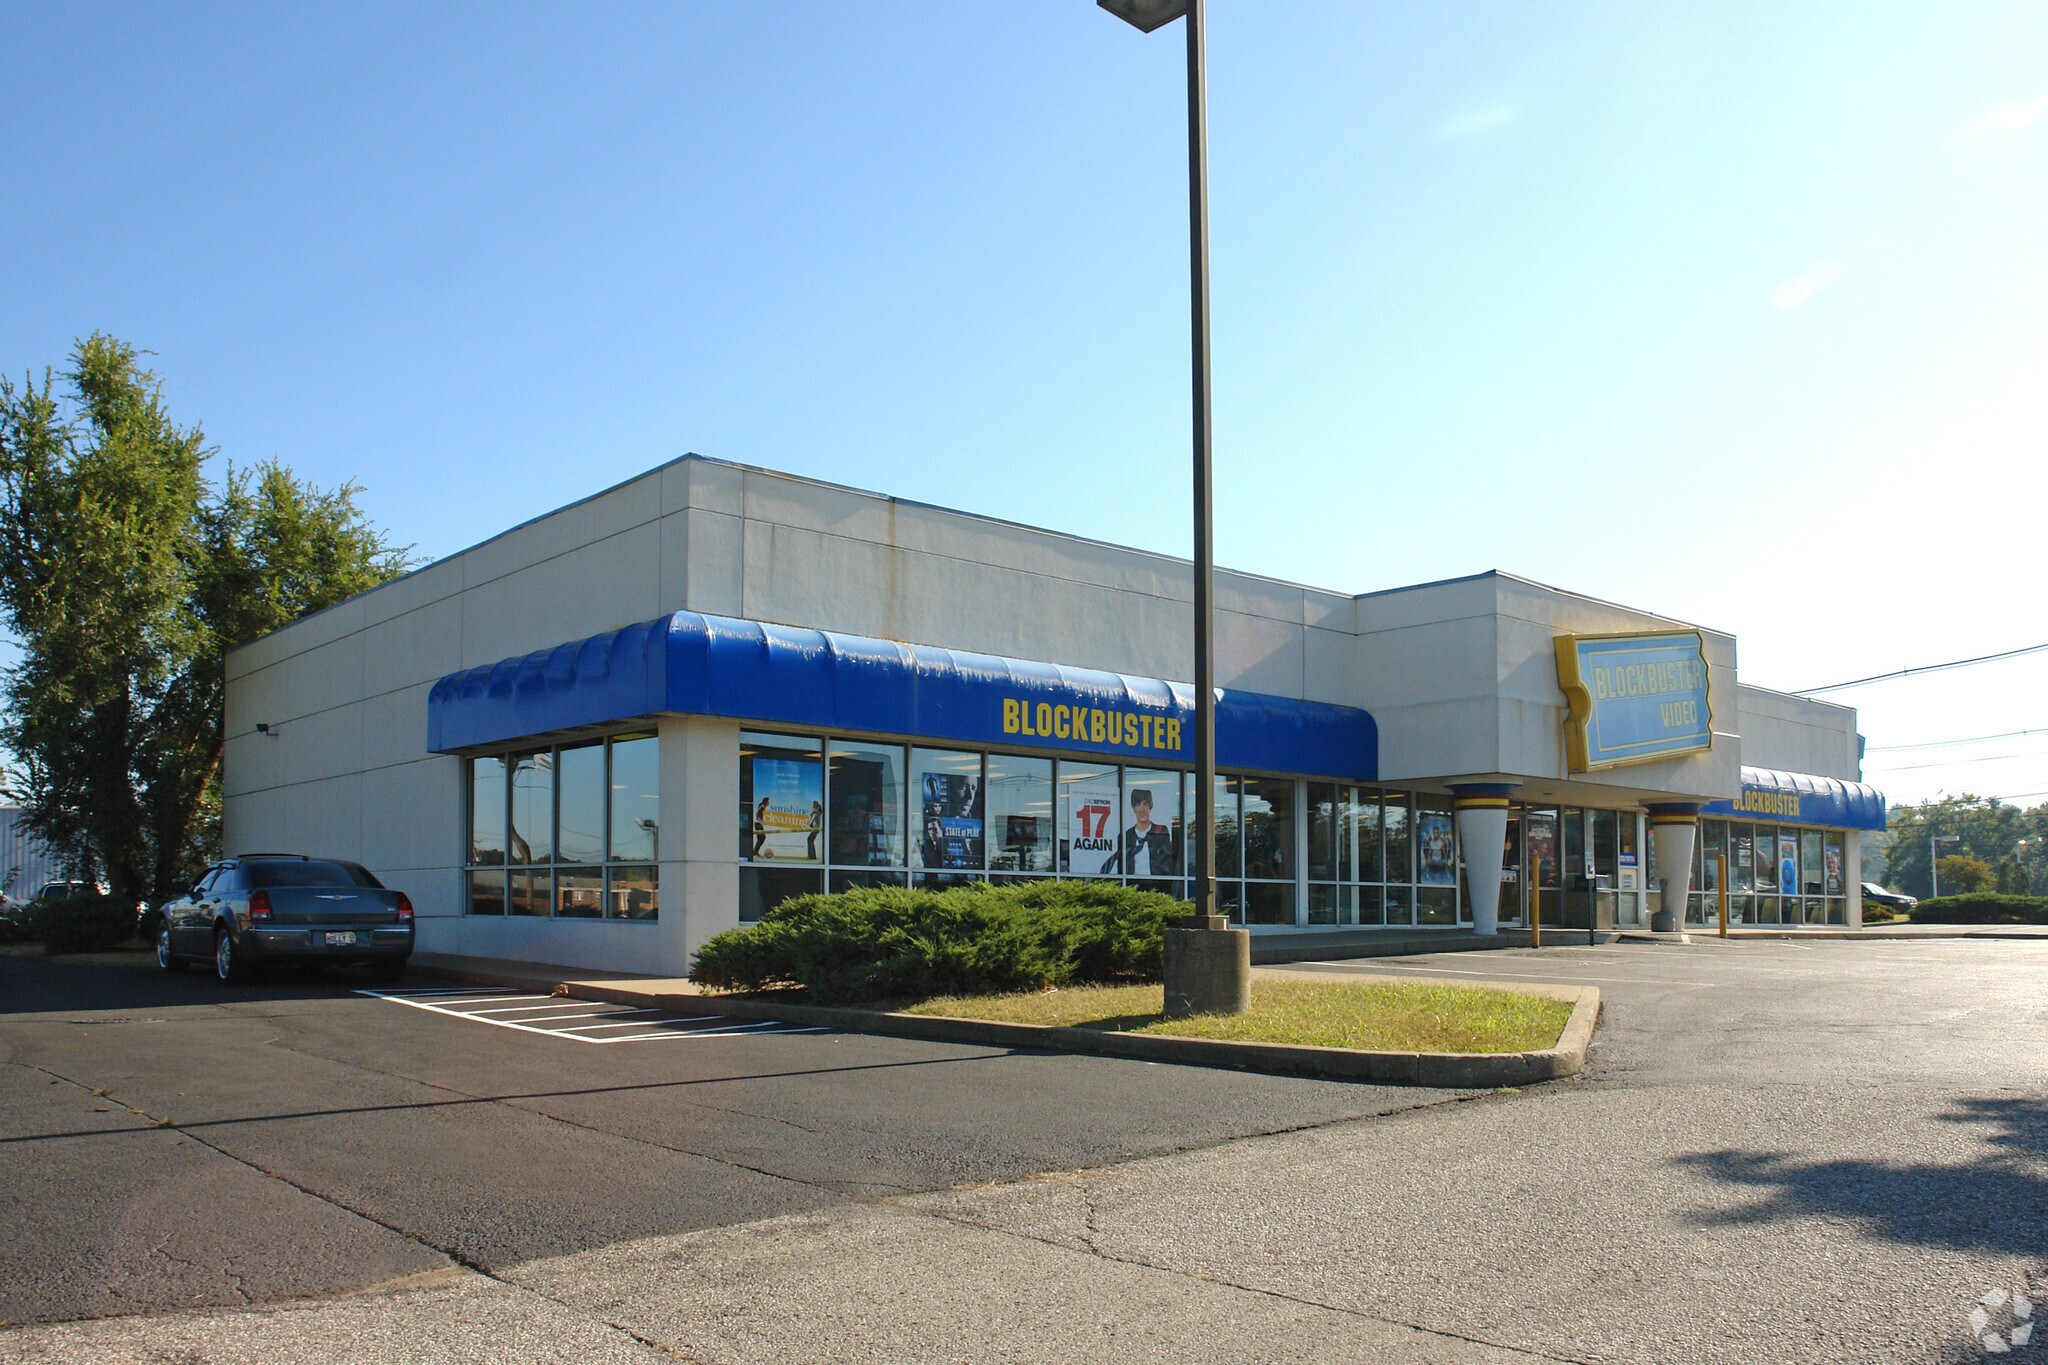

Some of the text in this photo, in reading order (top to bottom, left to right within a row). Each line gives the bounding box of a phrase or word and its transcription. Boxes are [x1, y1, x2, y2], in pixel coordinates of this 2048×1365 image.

[1595, 660, 1702, 699] BLOCKBUSTER
[1003, 698, 1181, 750] BLOCKBUSTER
[1660, 700, 1698, 728] VIDEO
[770, 804, 809, 815] sunshine
[763, 813, 808, 828] cleaning
[1076, 805, 1111, 838] 17
[945, 827, 961, 837] STATE
[966, 828, 980, 838] PLAY
[1073, 838, 1112, 851] AGAIN
